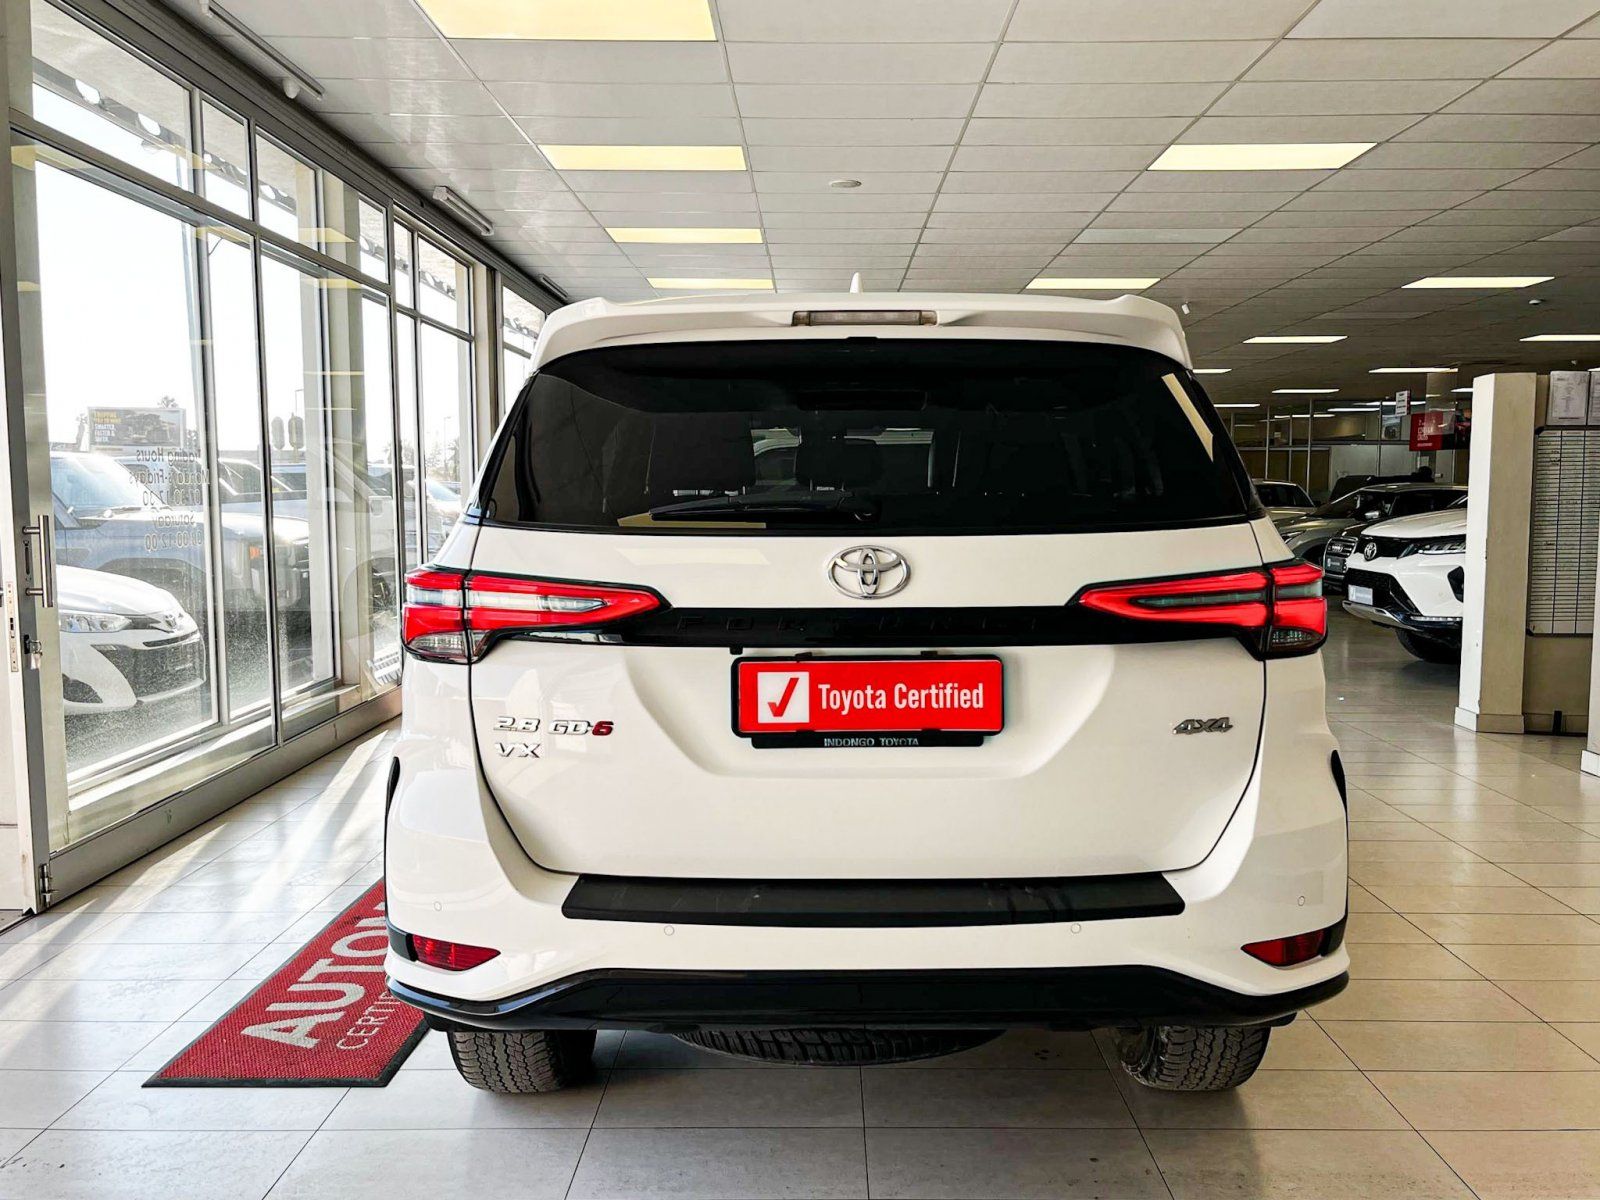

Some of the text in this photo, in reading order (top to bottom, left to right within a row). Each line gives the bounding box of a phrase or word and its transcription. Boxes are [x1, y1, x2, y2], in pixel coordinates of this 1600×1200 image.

[818, 683, 984, 715] Toyota Certified
[493, 716, 540, 733] 2.8
[495, 742, 540, 758] VX
[824, 737, 919, 747] INDONGO TOYOTA
